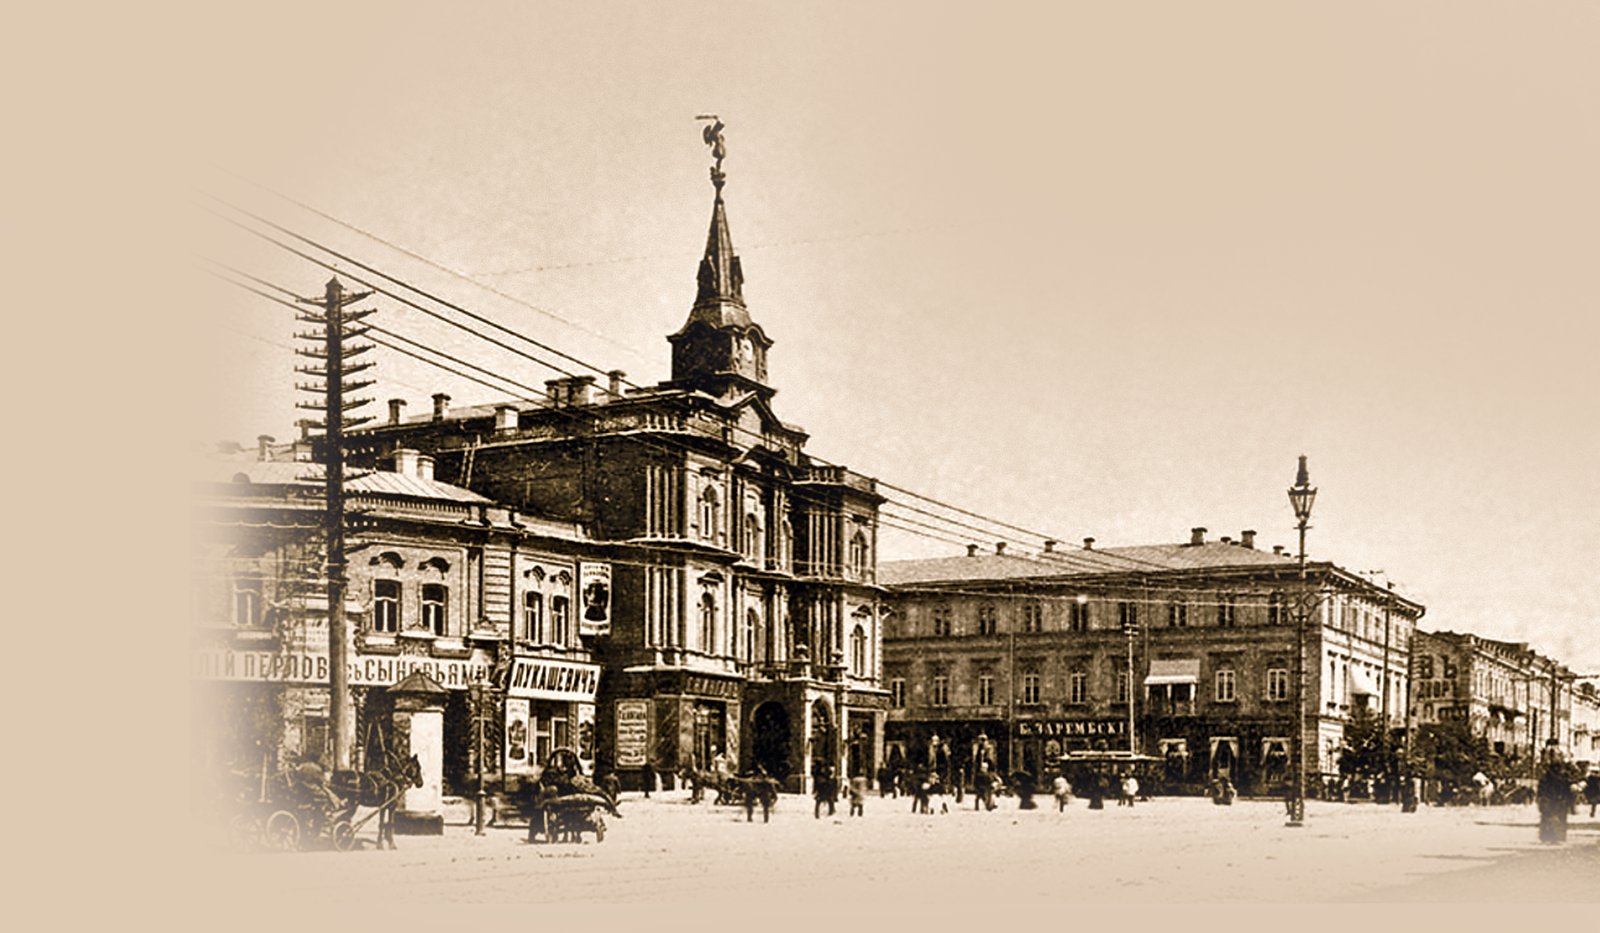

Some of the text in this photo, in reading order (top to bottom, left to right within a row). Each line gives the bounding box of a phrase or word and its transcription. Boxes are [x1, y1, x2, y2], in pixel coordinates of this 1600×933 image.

[244, 653, 329, 679] ПЕРЛОВ
[512, 663, 597, 693] ЛУКАШЕВИЧЪ
[1034, 721, 1125, 736] ЗАРЕМБСКІ
